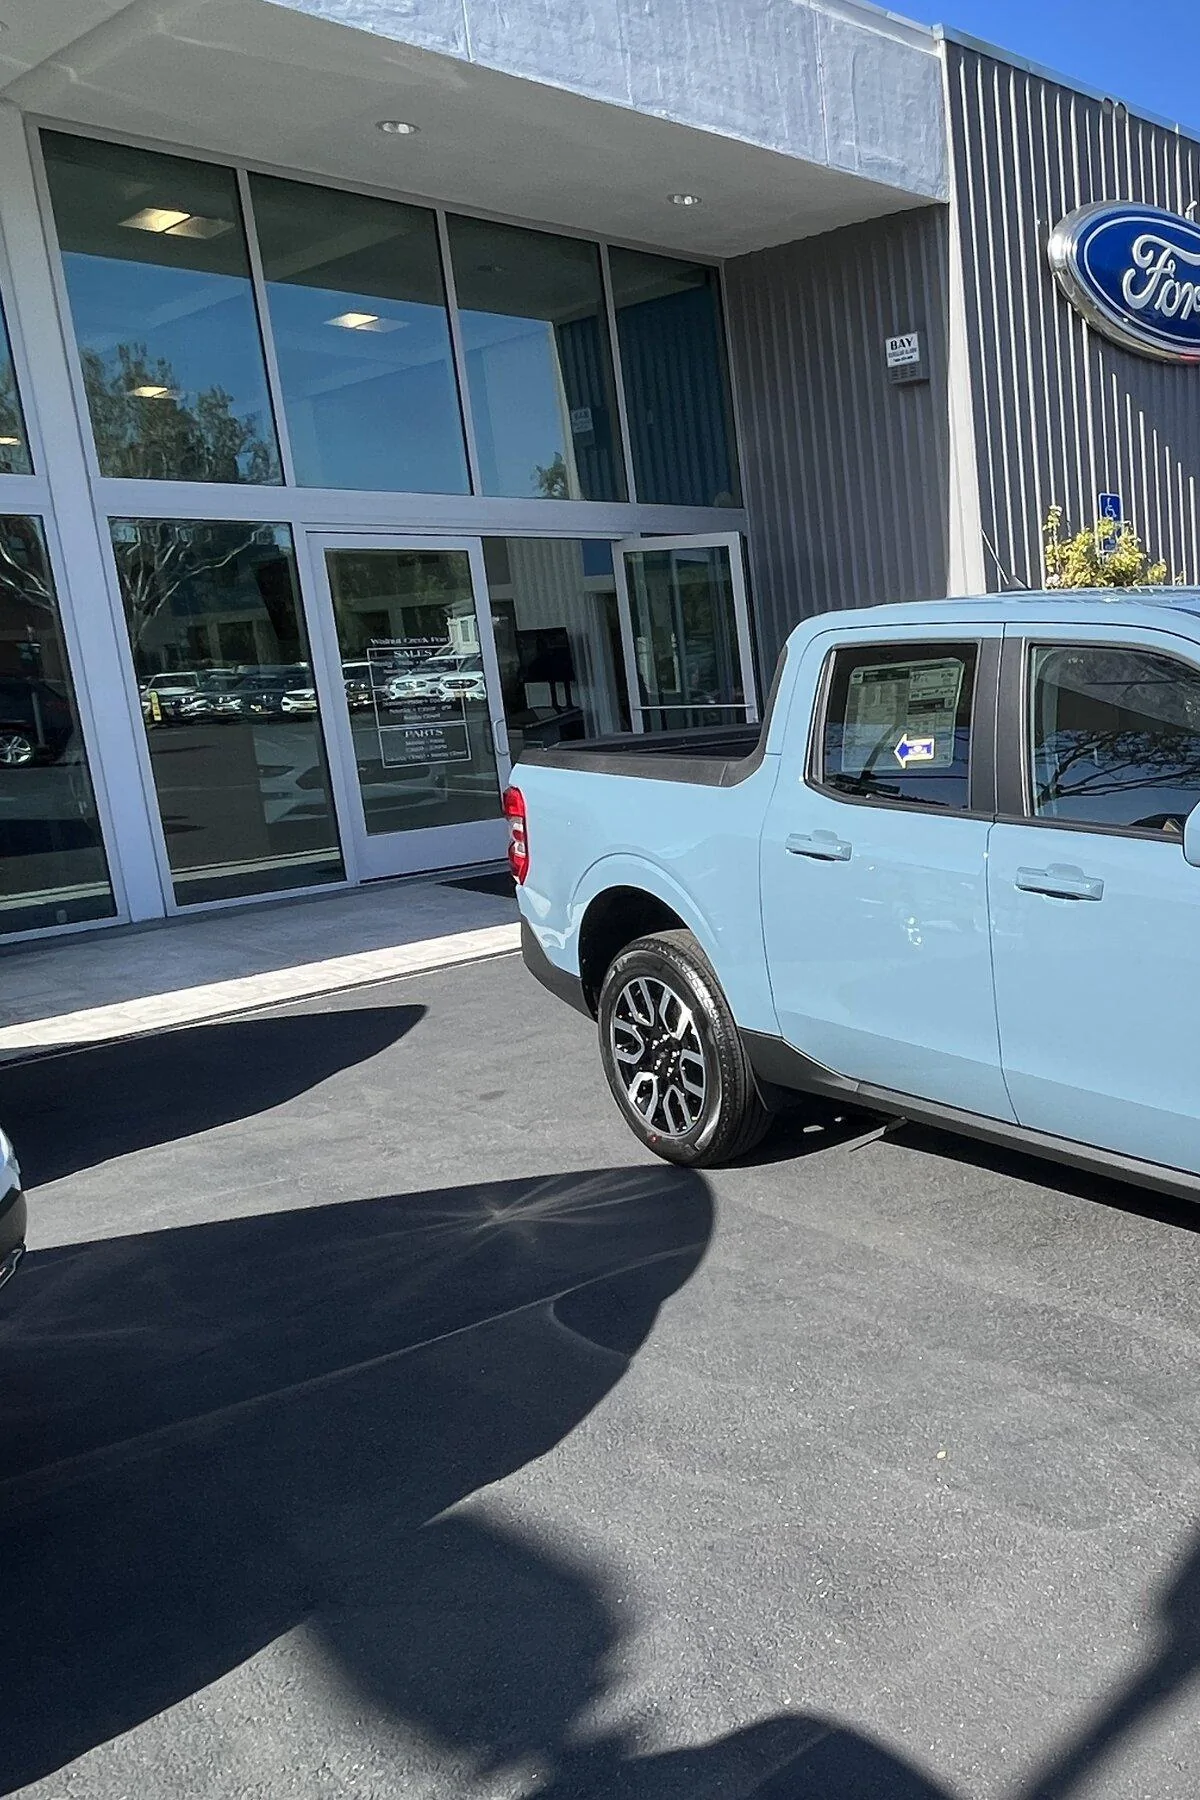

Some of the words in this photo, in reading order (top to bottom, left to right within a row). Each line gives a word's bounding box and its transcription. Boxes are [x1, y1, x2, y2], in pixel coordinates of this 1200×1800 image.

[890, 337, 913, 350] BAY
[393, 649, 433, 659] SALES
[404, 729, 443, 738] PARTS
